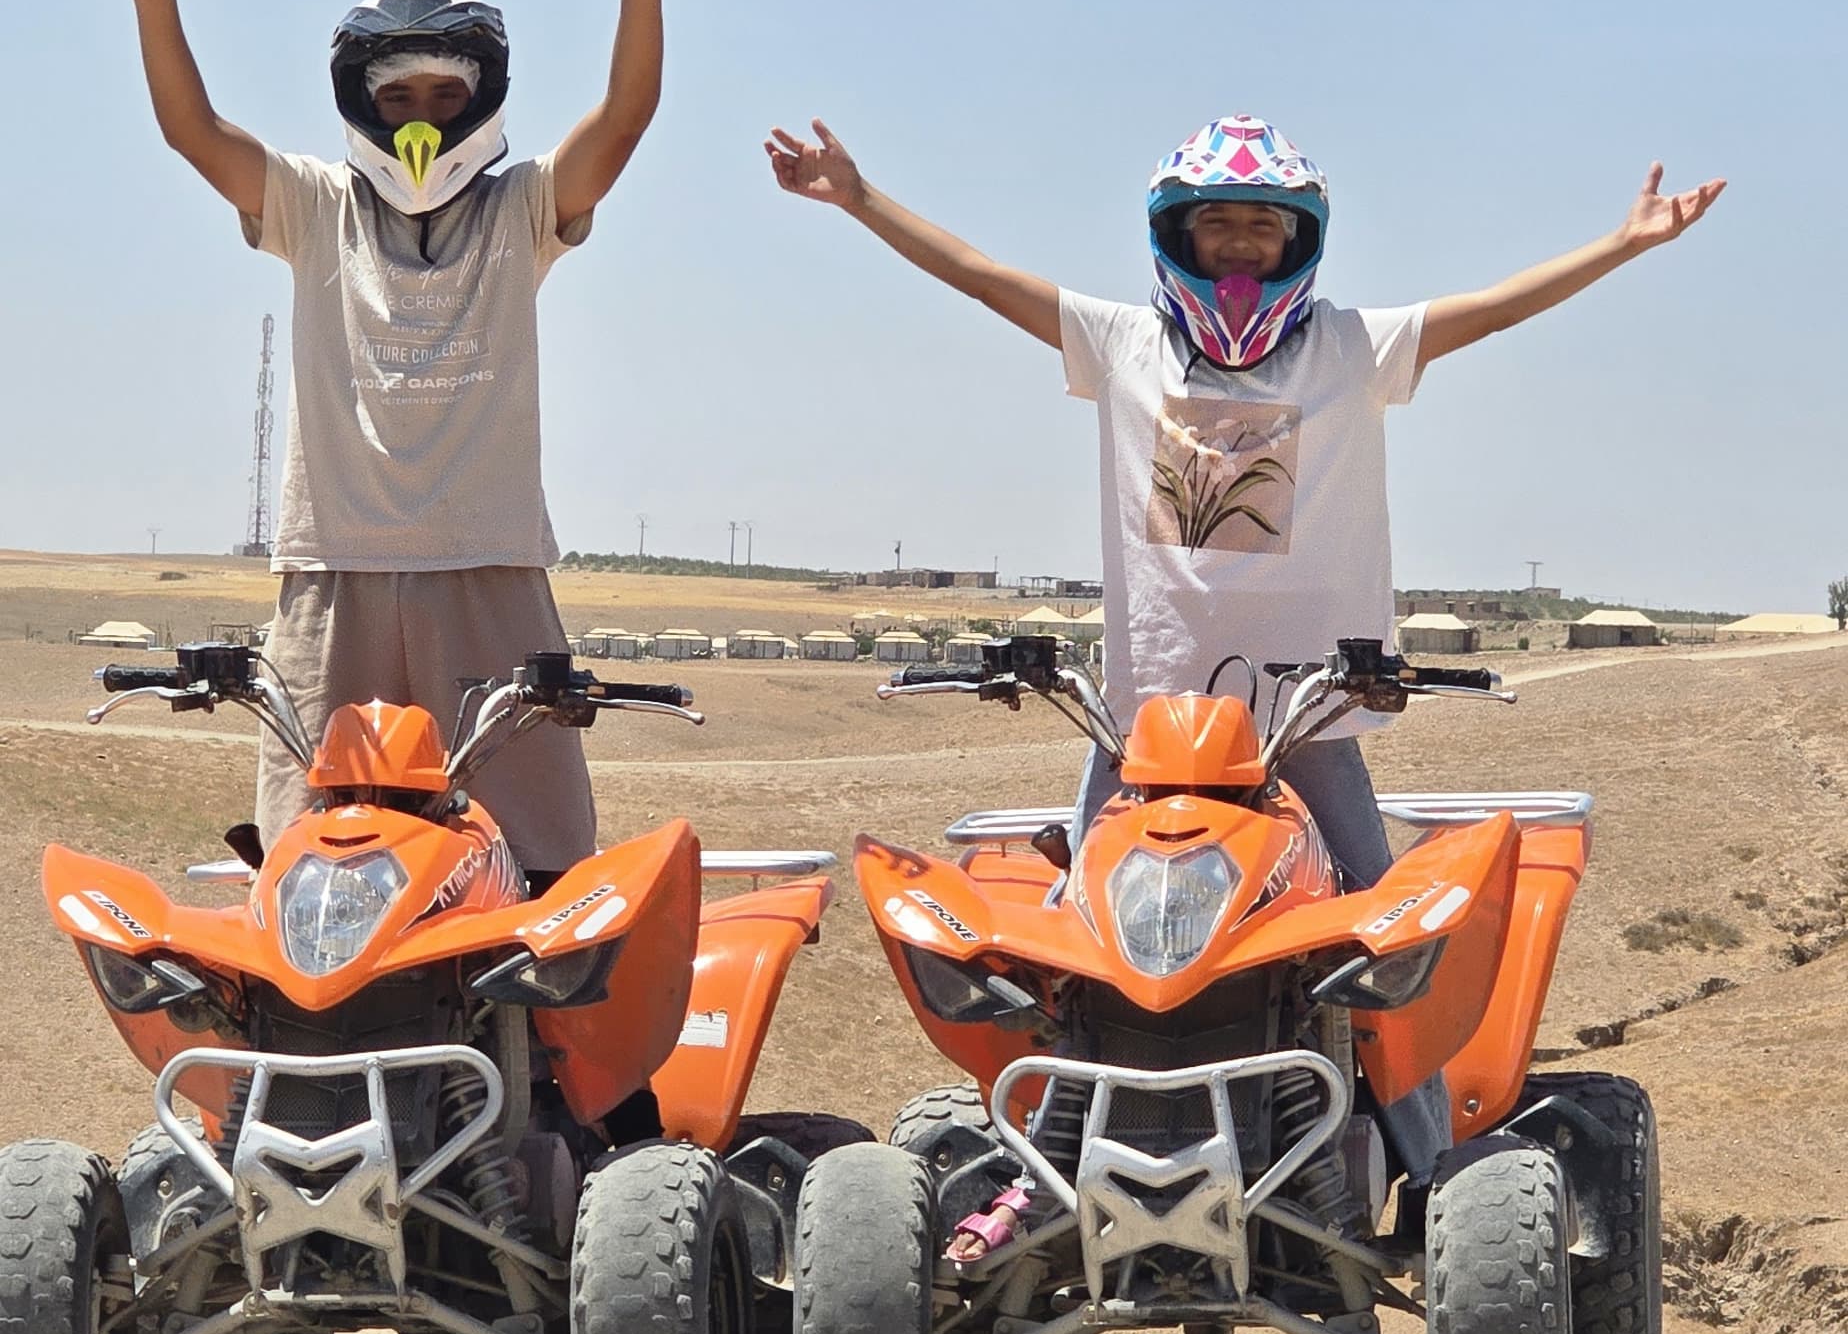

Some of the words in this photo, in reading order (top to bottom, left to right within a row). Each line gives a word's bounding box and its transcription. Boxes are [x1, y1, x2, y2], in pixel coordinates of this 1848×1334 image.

[407, 370, 495, 392] GARÇONS
[437, 847, 482, 908] KYMCO
[98, 900, 149, 937] IPONE
[551, 886, 611, 922] IPONE
[922, 900, 977, 940] IPONE
